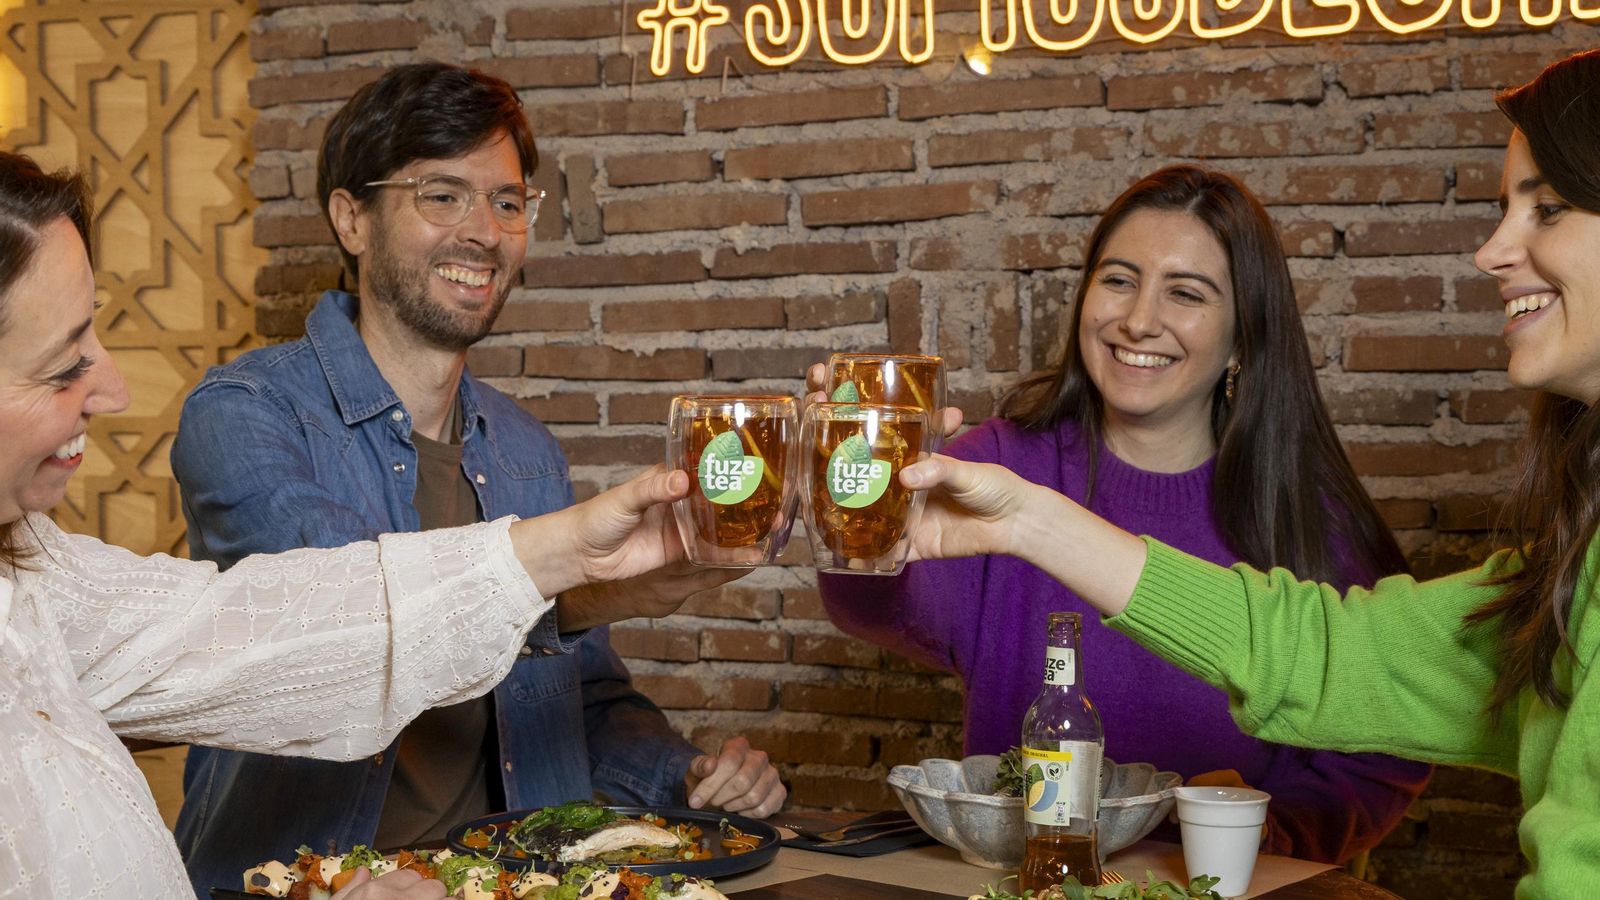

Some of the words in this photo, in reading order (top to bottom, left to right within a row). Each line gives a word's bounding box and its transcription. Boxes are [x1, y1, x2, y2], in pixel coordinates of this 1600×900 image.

[705, 453, 755, 476] fuze
[833, 456, 883, 479] fuze
[704, 473, 743, 490] tea
[832, 476, 870, 494] tea
